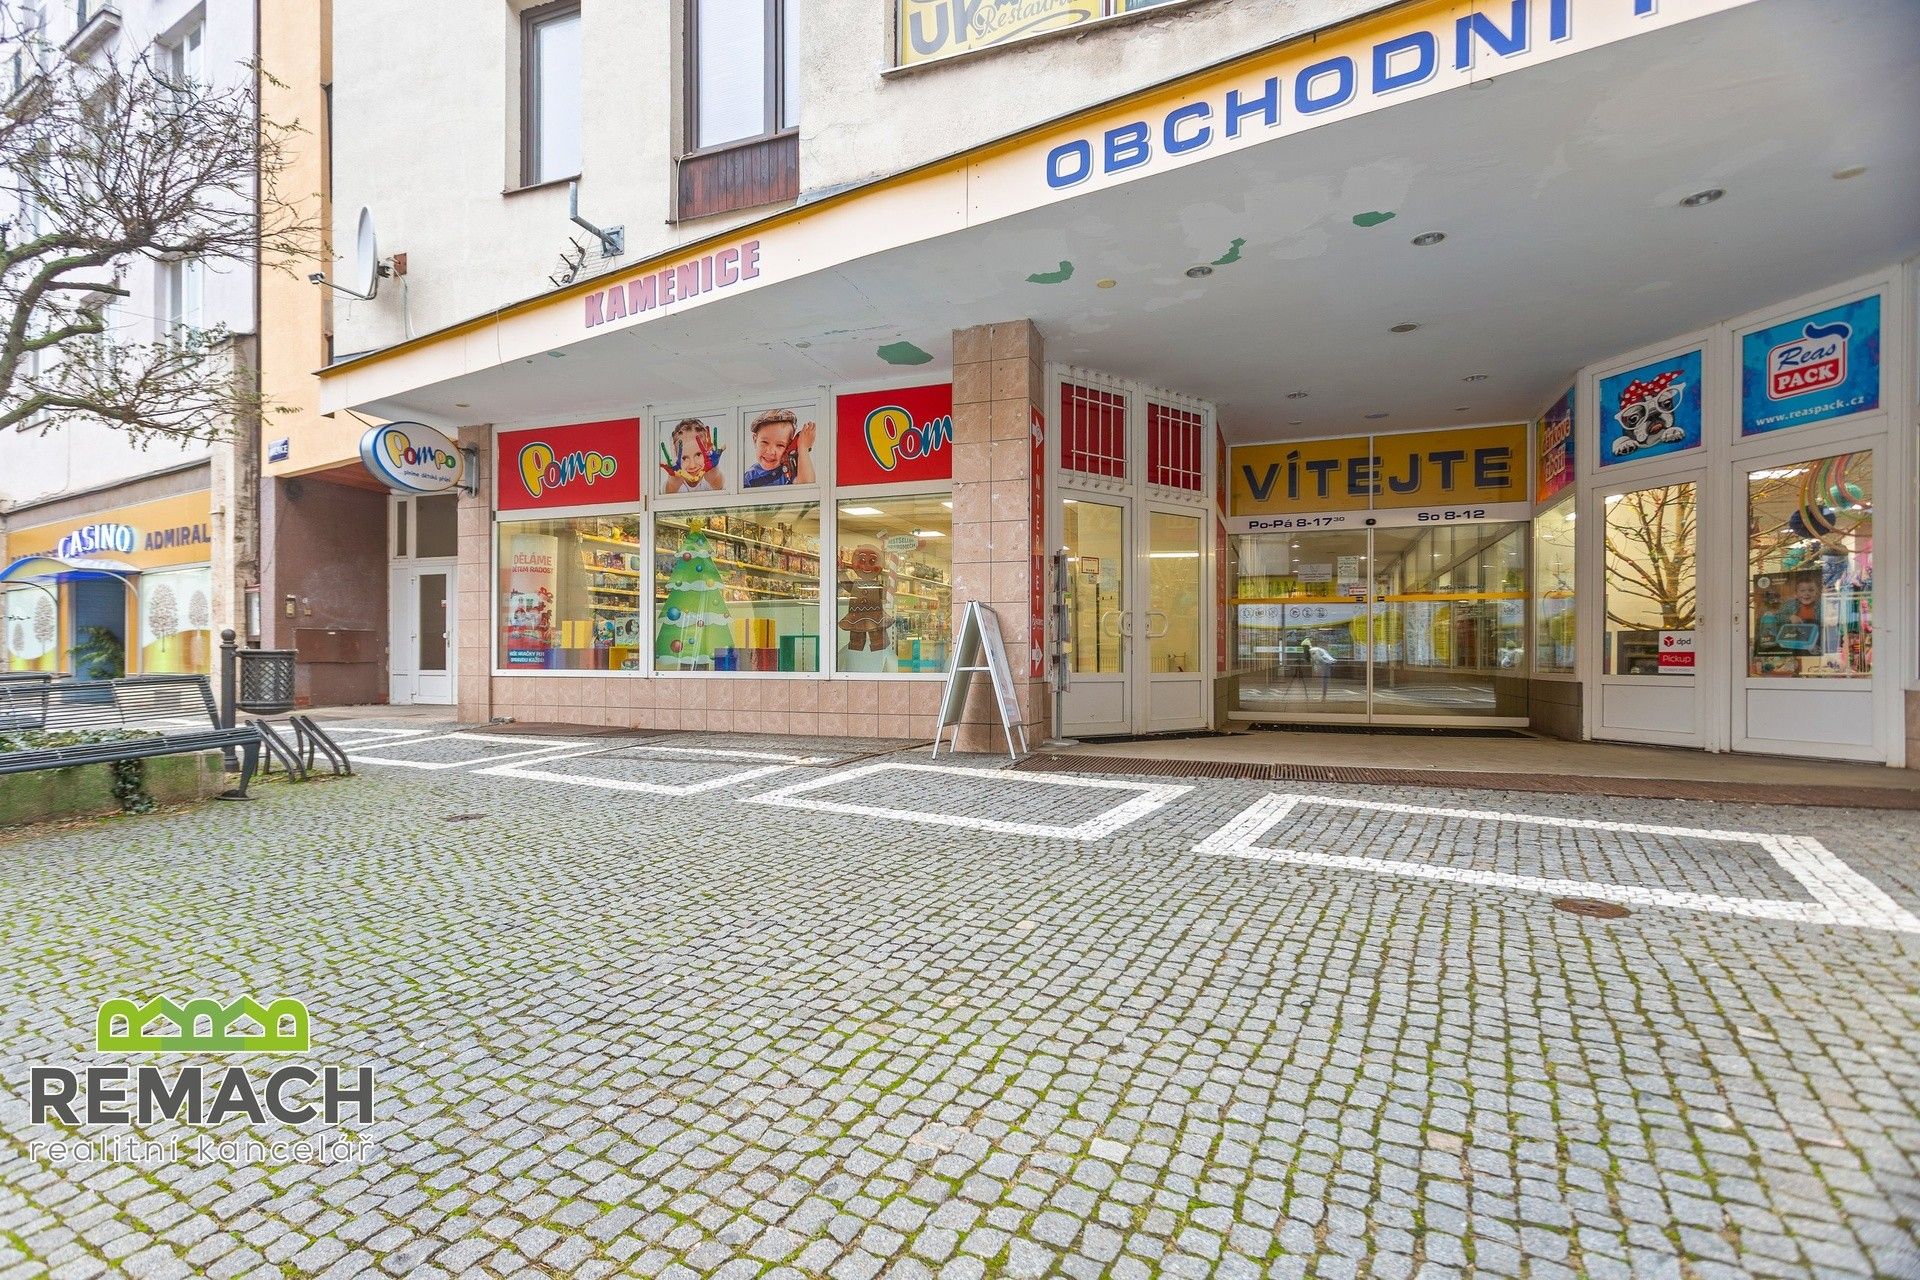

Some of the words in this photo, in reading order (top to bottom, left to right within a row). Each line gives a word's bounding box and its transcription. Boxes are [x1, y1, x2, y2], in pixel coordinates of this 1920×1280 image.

[585, 240, 760, 328] KAMENICE
[1776, 343, 1837, 371] Reas
[1776, 361, 1837, 391] PACK
[1756, 396, 1865, 427] www.reaspack.cz
[383, 429, 456, 470] Pompo
[518, 441, 617, 498] Pompo
[1242, 447, 1515, 502] VÍTEJTE
[1249, 517, 1294, 530] Po-Pá
[1417, 512, 1441, 523] So
[1444, 509, 1486, 520] 8-12
[57, 524, 133, 558] CASINO
[144, 523, 211, 551] ADMIRAL
[1662, 655, 1692, 664] Pickup
